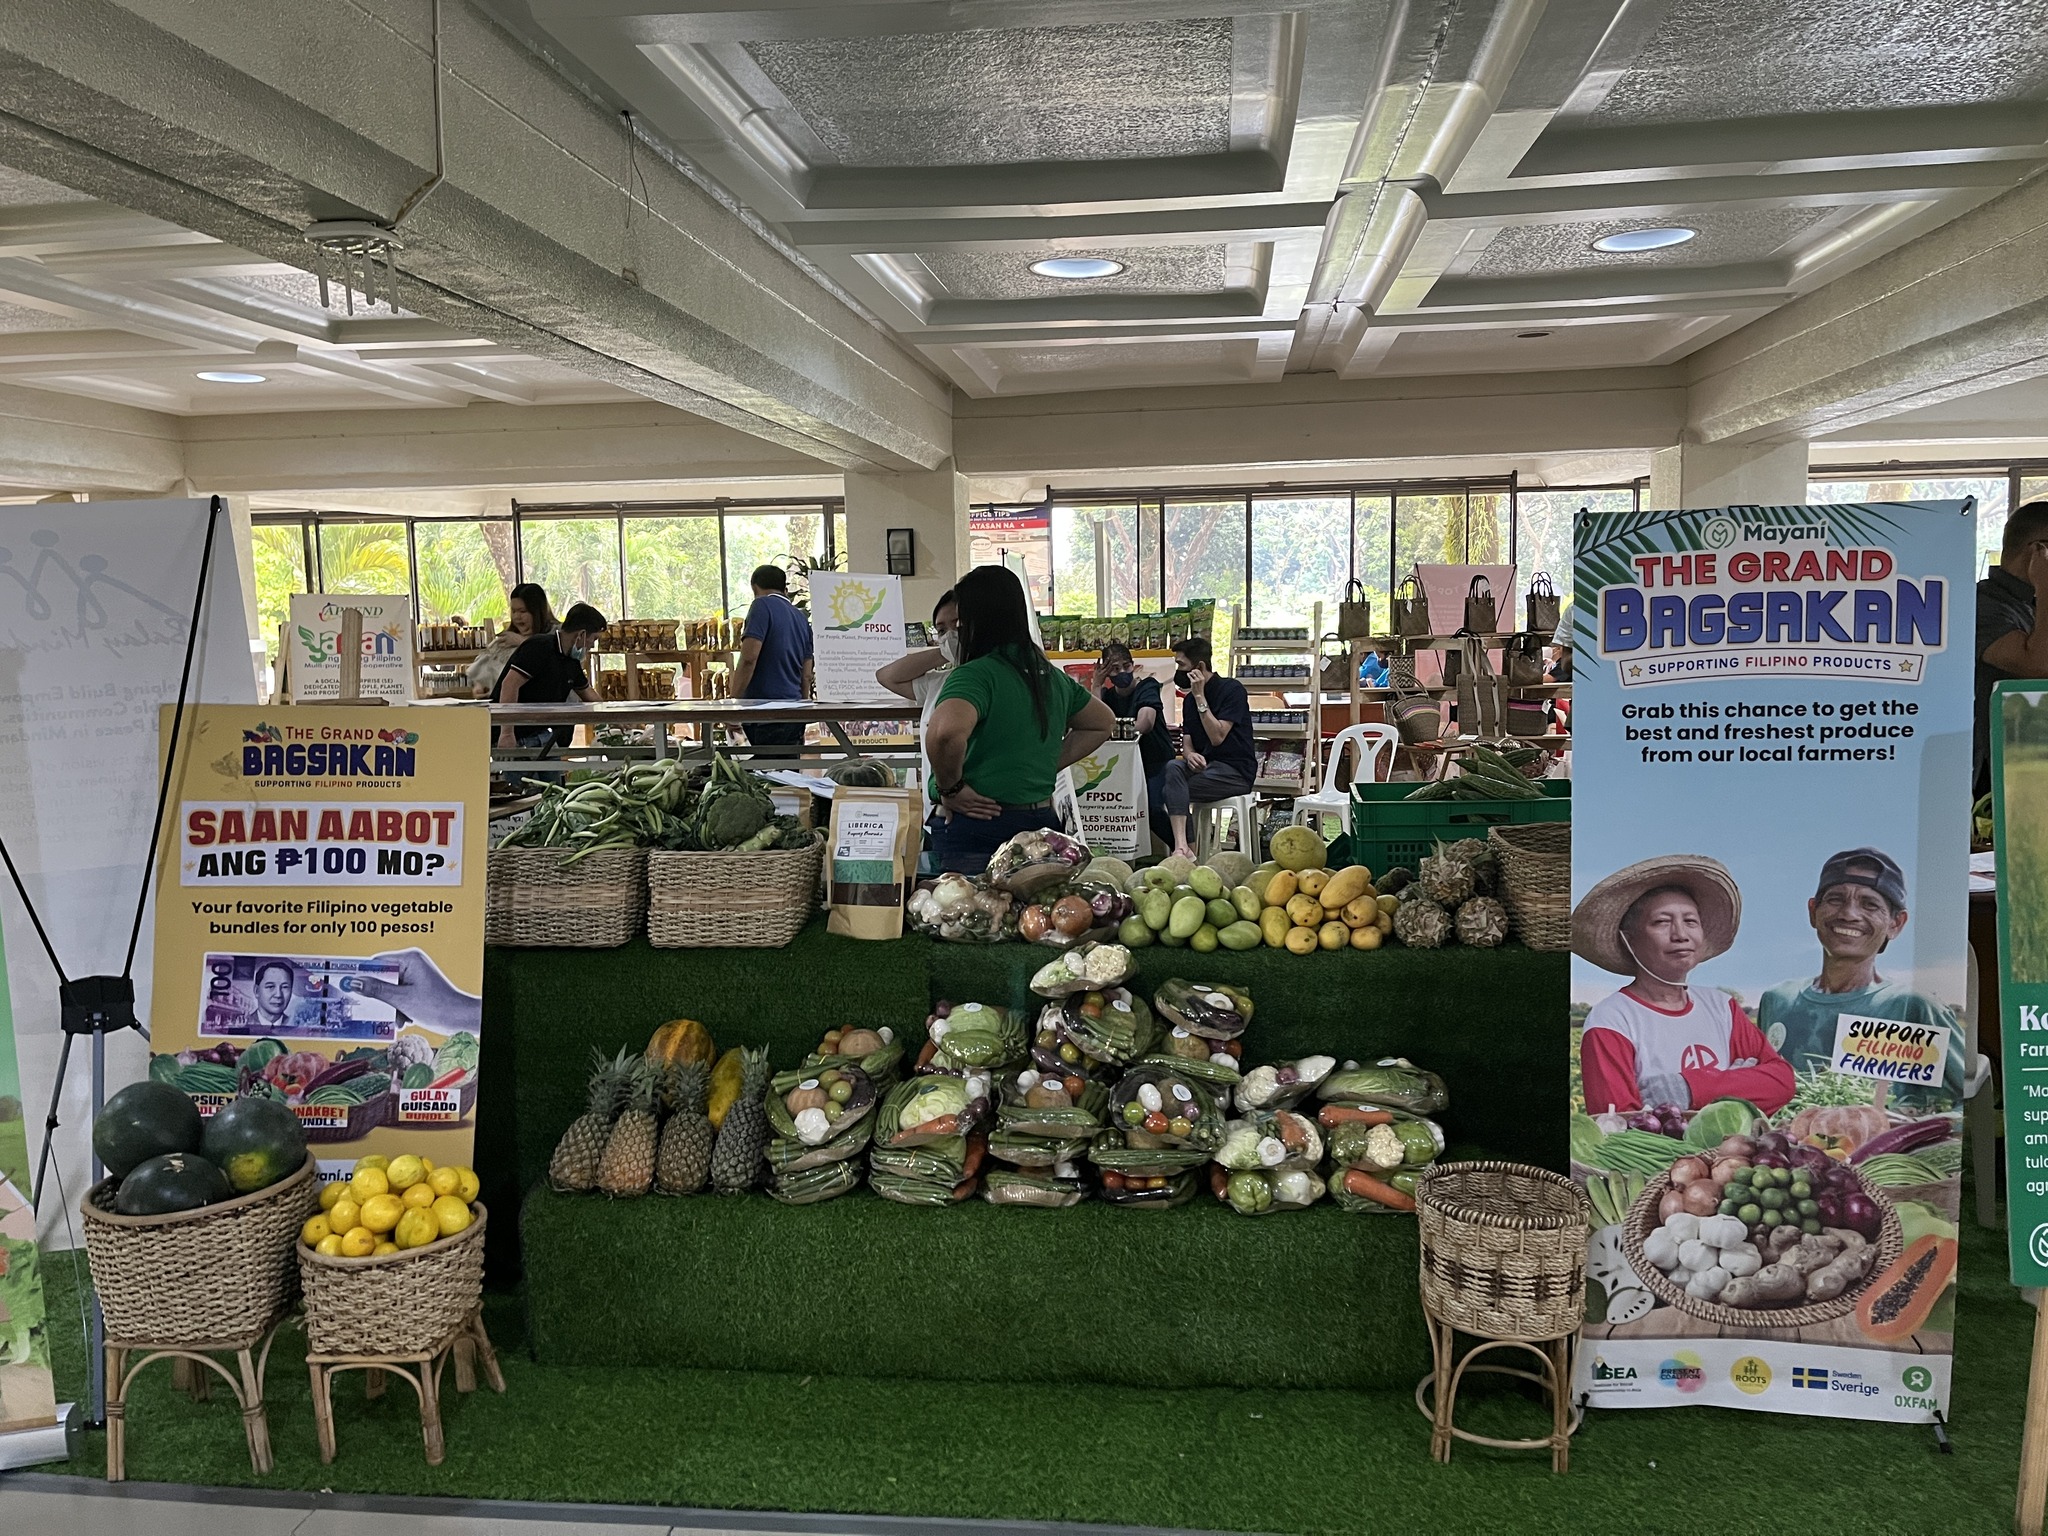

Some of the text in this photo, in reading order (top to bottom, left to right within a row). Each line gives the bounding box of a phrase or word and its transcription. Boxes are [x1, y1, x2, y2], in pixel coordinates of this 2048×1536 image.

[1634, 550, 1893, 588] THE GRAND
[1602, 578, 1944, 654] BAGSAKAN
[864, 623, 892, 633] FPSDC
[1648, 656, 1892, 674] SUPPORTING FILIPINO PRODUCTS
[1621, 700, 1920, 720] Grab this chance to get the
[1625, 723, 1914, 744] best and freshest produce
[242, 743, 416, 777] BAGSAKAN
[1641, 744, 1896, 762] from our local farmers!
[254, 780, 402, 788] SUPPORTING FILIPINO PRODUCTS
[1086, 792, 1122, 802] FPSDC
[186, 808, 456, 846] SAAN AABOT
[1082, 824, 1136, 832] COOPERATIVE
[197, 847, 445, 878] ANG ₱100 MO?
[192, 900, 453, 917] Your favorite Filipino vegetable
[209, 920, 434, 937] bundles for only 100 pesos!
[370, 1024, 390, 1036] 100
[1848, 1020, 1940, 1047] SUPPORT
[1856, 1040, 1924, 1060] FILIPINO
[1840, 1052, 1935, 1081] FARMERS
[410, 1090, 449, 1102] GULAY
[400, 1100, 457, 1112] GUISADO
[405, 1112, 452, 1121] BUNDLE
[1735, 1374, 1767, 1384] ROOTS
[1832, 1369, 1862, 1380] Sweden
[1831, 1380, 1880, 1397] Sverige
[1894, 1394, 1938, 1411] OXFAM
